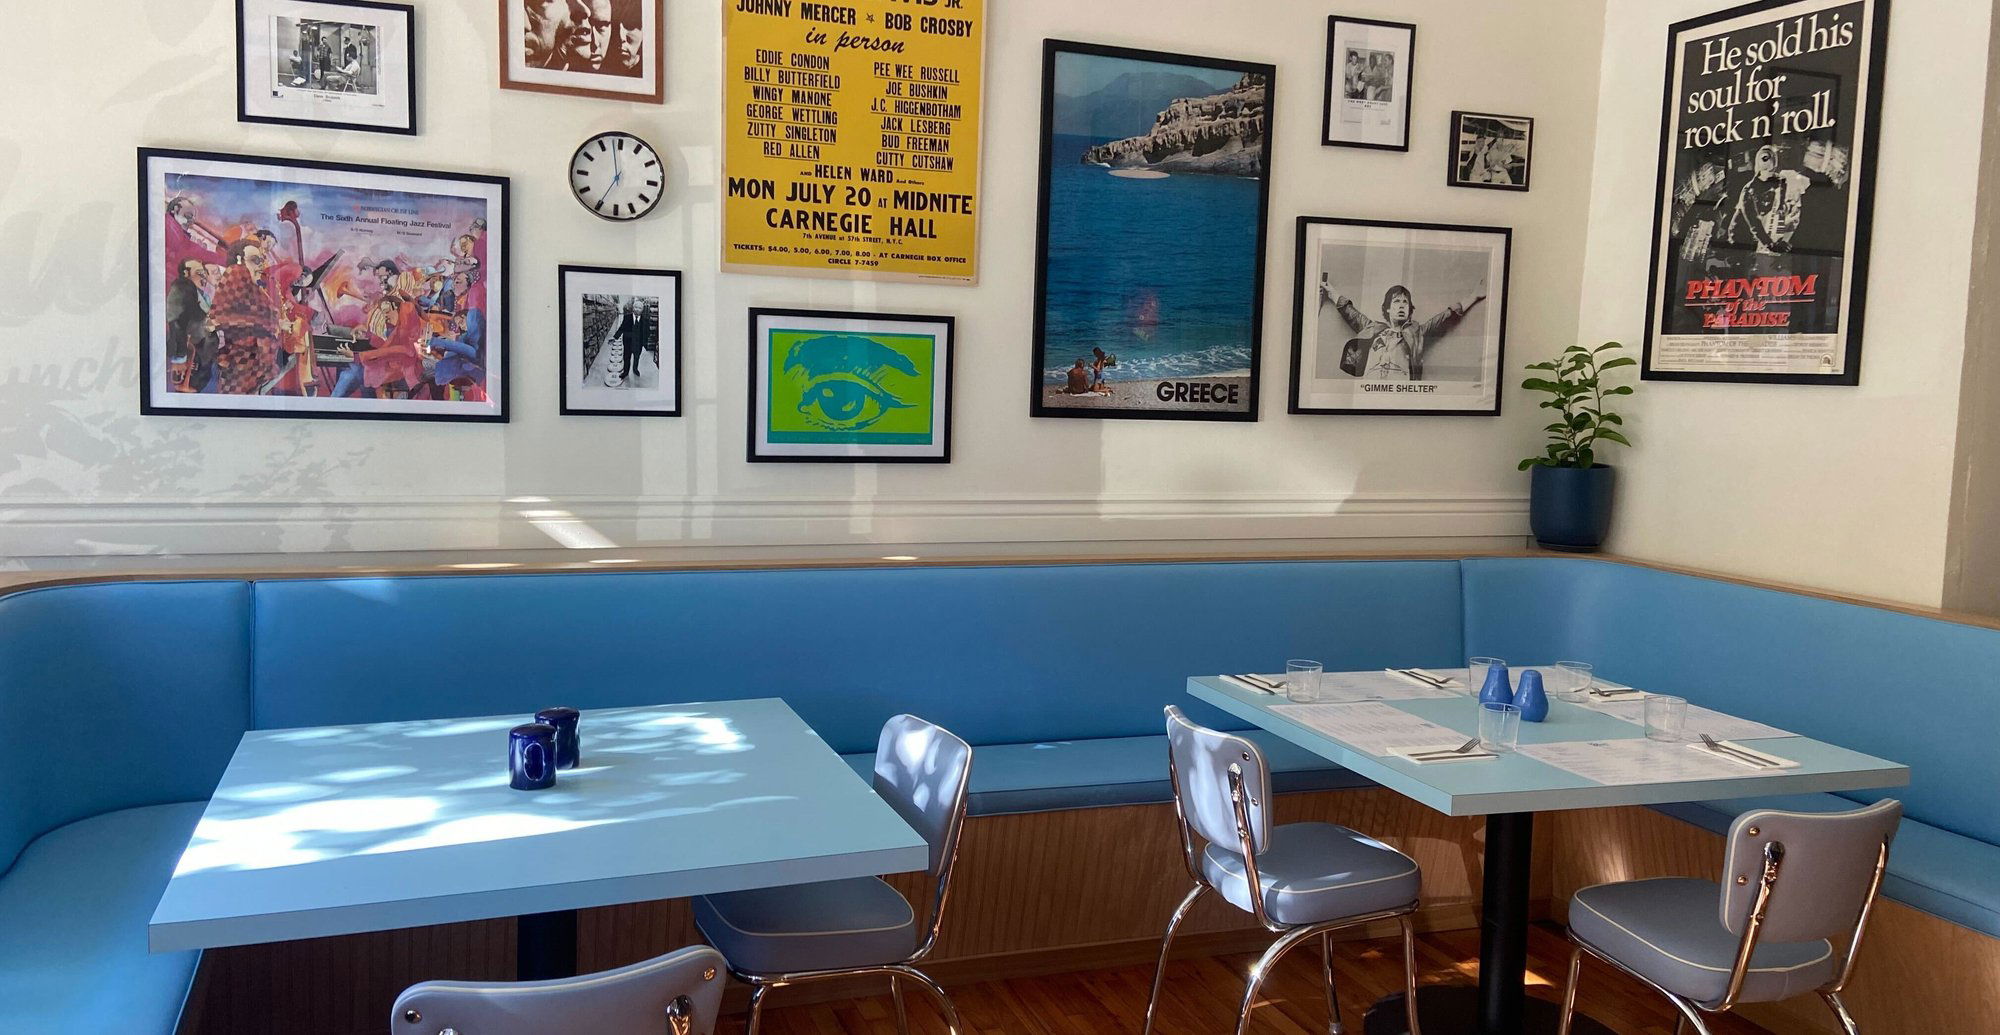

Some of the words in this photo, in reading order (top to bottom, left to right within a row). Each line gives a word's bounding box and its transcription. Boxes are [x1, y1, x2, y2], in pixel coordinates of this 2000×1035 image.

[736, 0, 792, 17] JOHNNY
[800, 2, 856, 26] MERCER
[885, 12, 912, 31] BOB
[920, 16, 973, 37] CROSBY
[805, 27, 827, 45] in
[834, 32, 905, 53] person
[1701, 36, 1742, 76] He
[1745, 18, 1803, 66] sold
[1806, 13, 1854, 53] his
[756, 48, 784, 66] EDDIE
[791, 53, 830, 70] CONDON
[744, 66, 770, 82] BILLY
[778, 70, 840, 90] BUTTERFIELD
[874, 62, 890, 77] PEE
[895, 64, 914, 79] WEE
[920, 66, 960, 84] RUSSELL
[752, 85, 784, 102] WINGY
[792, 90, 832, 106] MANONE
[886, 81, 902, 96] JOE
[910, 83, 948, 100] BUSHKIN
[1688, 69, 1742, 114] soul
[1746, 64, 1787, 104] for
[746, 103, 784, 120] GEORGE
[792, 107, 838, 125] WETTLING
[894, 100, 961, 119] HIGGENBOTHAM
[747, 122, 776, 138] ZUTTY
[785, 125, 836, 143] SINGLETON
[881, 116, 903, 132] JACK
[910, 119, 950, 135] LESBERG
[1684, 106, 1744, 150] rock
[764, 141, 782, 156] RED
[790, 144, 820, 160] ALLEN
[882, 134, 900, 148] BUD
[906, 136, 949, 152] FREEMAN
[876, 152, 904, 166] CUTTY
[912, 154, 954, 170] CUTSHAW
[814, 164, 852, 180] HELEN
[860, 168, 893, 184] WARD
[728, 176, 775, 200] MON
[785, 182, 836, 204] JULY
[845, 186, 871, 206] 20
[878, 197, 888, 209] AT
[893, 190, 973, 215] MIDNITE
[320, 213, 334, 221] The
[355, 216, 379, 224] Annual
[380, 218, 408, 228] Floating
[410, 220, 424, 228] Jazz
[426, 221, 452, 229] Festival
[766, 208, 872, 234] CARNEGIE
[890, 216, 937, 239] HALL
[891, 253, 924, 261] CARNEGIE
[944, 256, 966, 264] OFFICE
[1685, 274, 1818, 300] PHANTOM
[1726, 298, 1744, 313] of
[1746, 298, 1766, 312] the
[1702, 311, 1791, 328] PARADISE
[1156, 381, 1238, 404] GREECE
